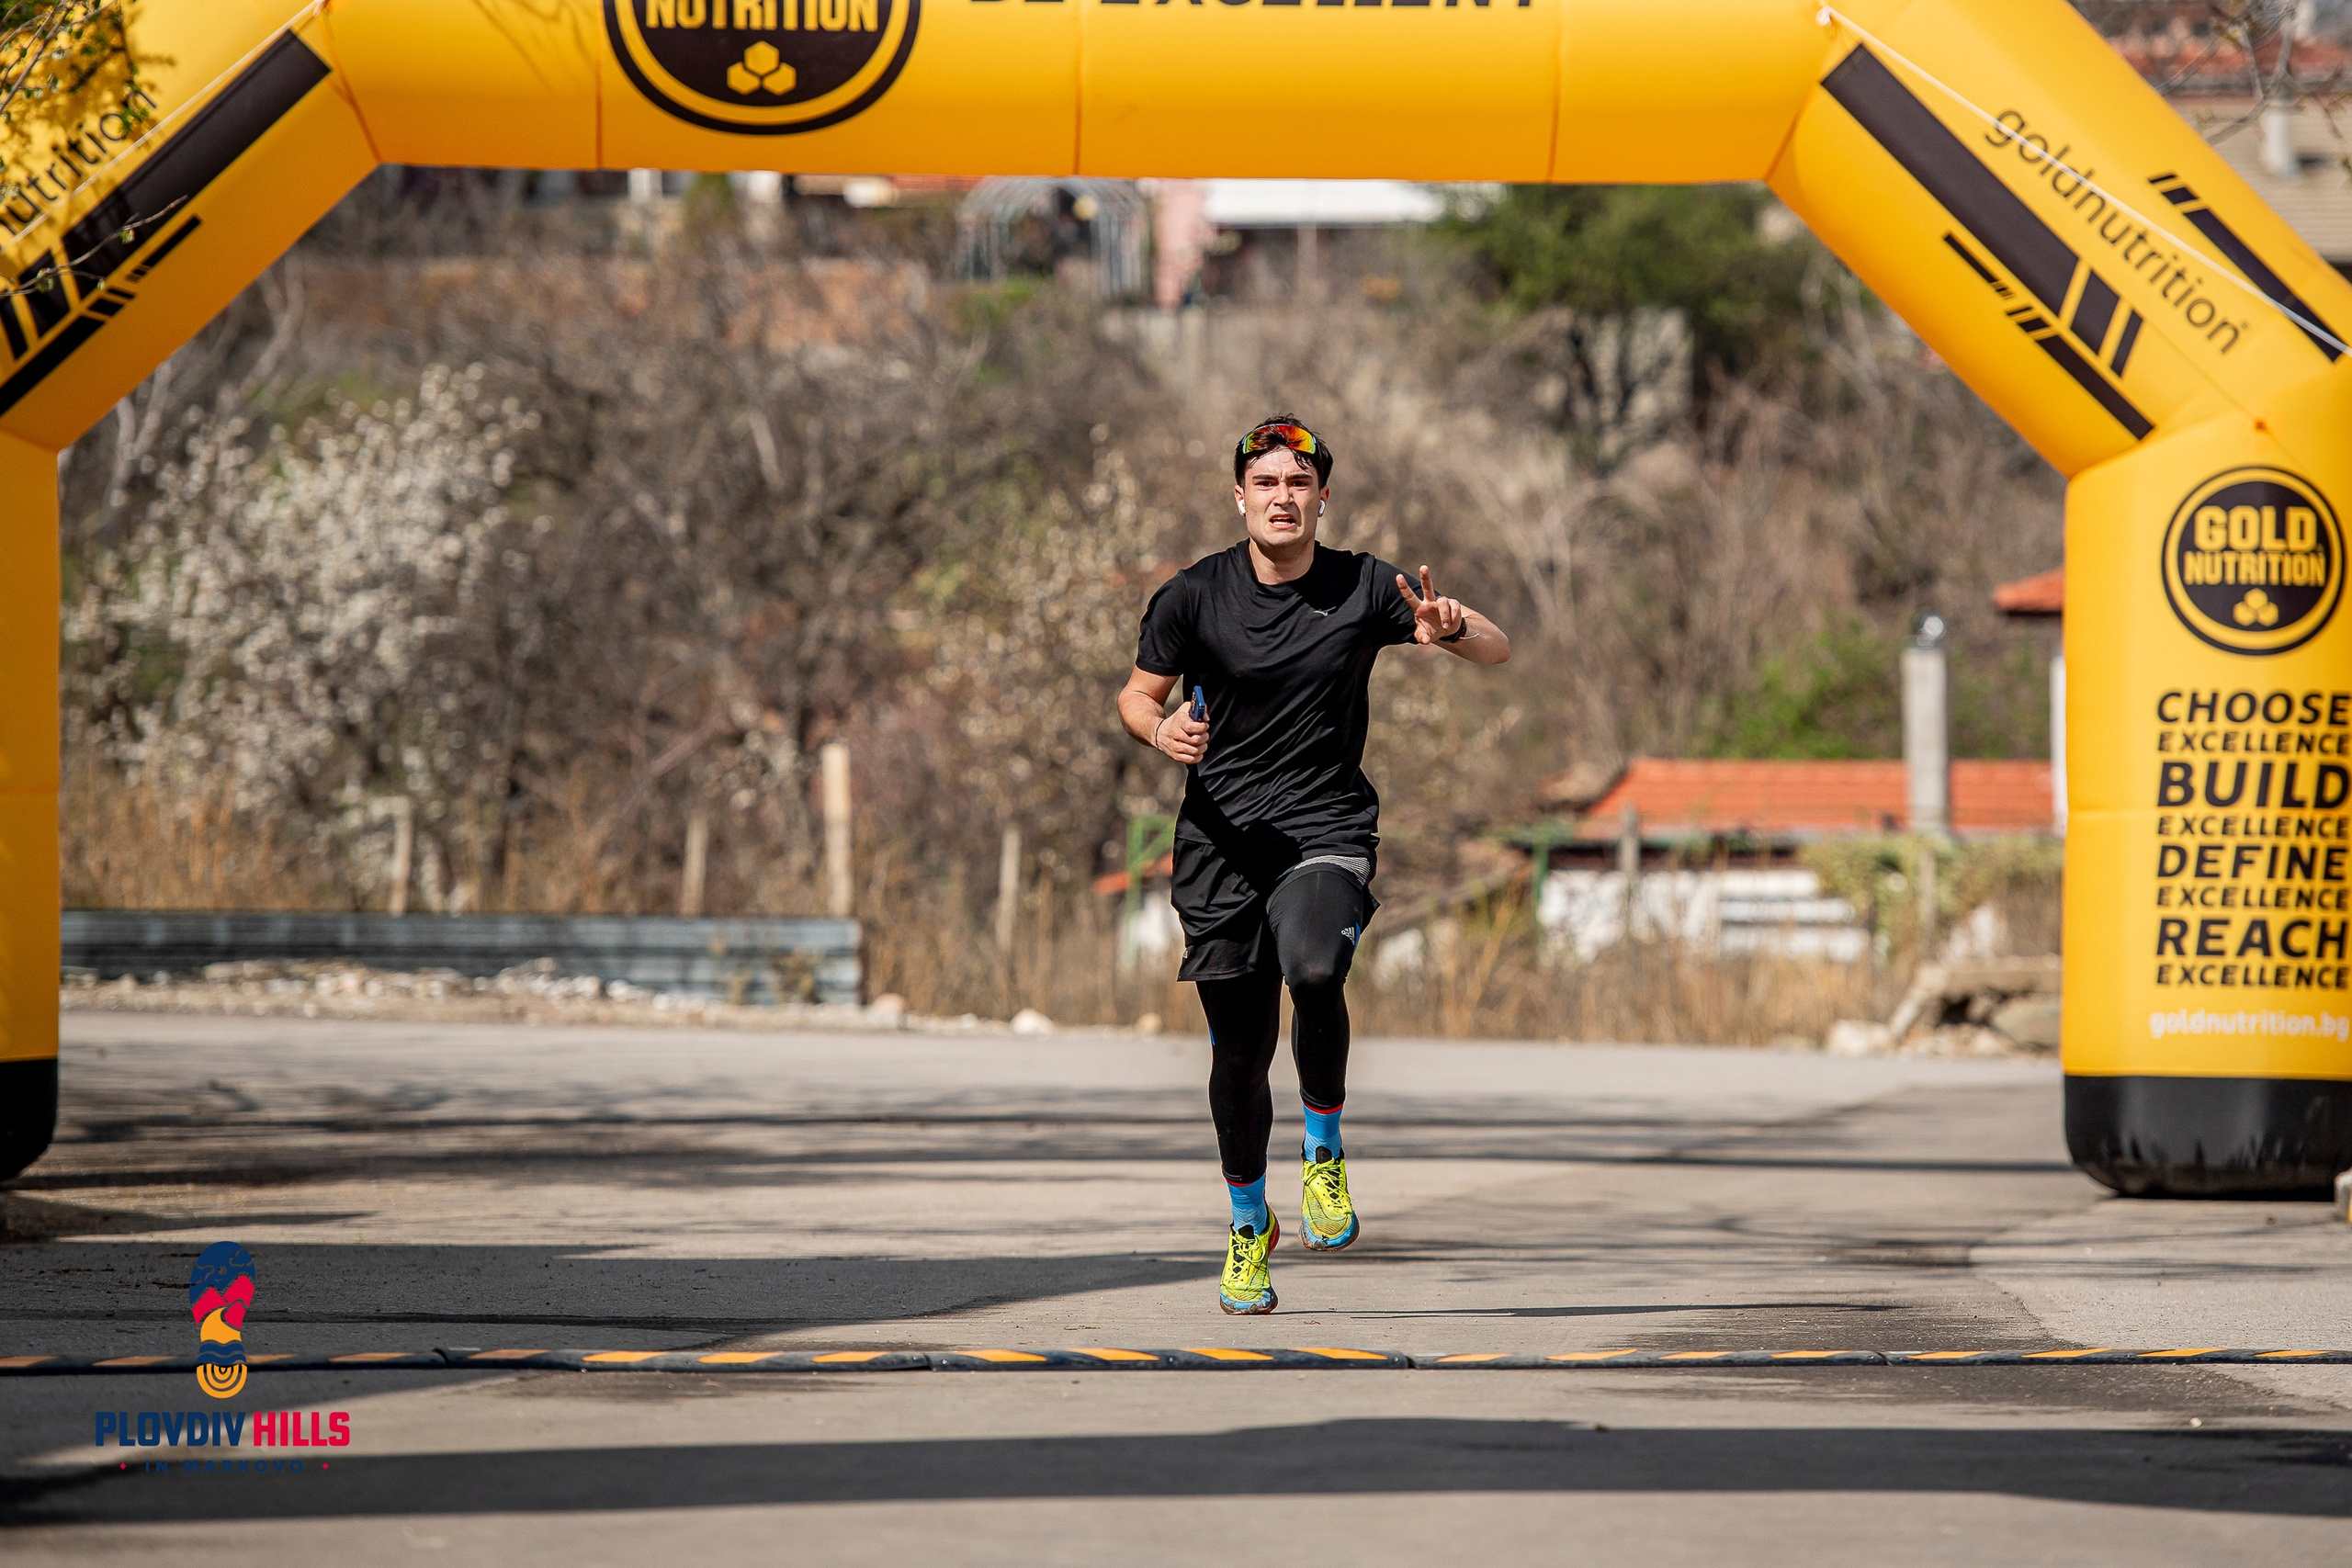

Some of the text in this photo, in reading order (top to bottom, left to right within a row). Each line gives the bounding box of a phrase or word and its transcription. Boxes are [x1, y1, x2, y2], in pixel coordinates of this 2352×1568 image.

[2194, 505, 2317, 551] GOLD
[2184, 550, 2326, 586] NUTRITION
[2157, 692, 2352, 726] CHOOSE
[2157, 731, 2351, 754] EXCELLENCE
[2157, 761, 2350, 809] BUILD
[2157, 816, 2351, 839] EXCELLENCE
[2157, 845, 2348, 881] DEFINE
[2156, 887, 2350, 909] EXCELLENCE
[2156, 919, 2348, 959] REACH
[2156, 964, 2349, 988] EXCELLENCE
[2150, 1008, 2350, 1043] goldnutrition.bg
